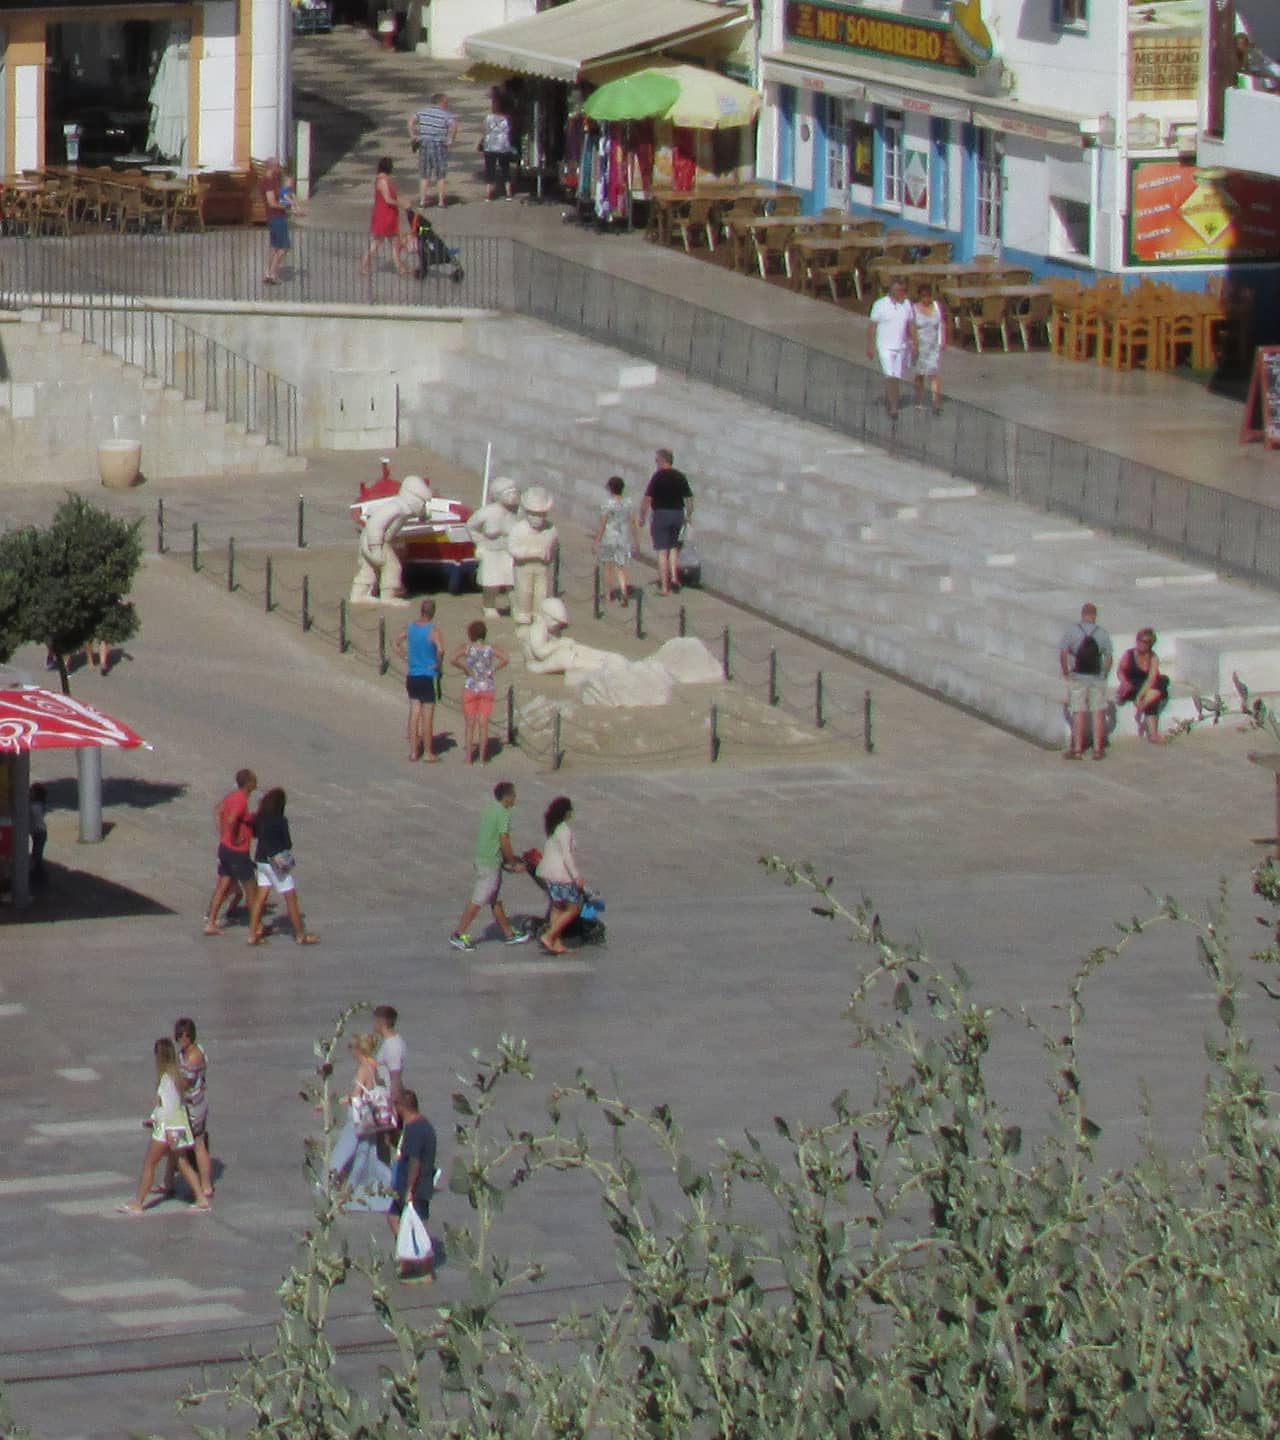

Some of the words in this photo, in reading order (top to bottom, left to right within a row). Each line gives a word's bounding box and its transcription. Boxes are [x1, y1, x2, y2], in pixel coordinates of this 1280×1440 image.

[817, 10, 838, 40] MI
[846, 16, 941, 60] SOMBRERO
[1135, 53, 1200, 65] MEXICANO
